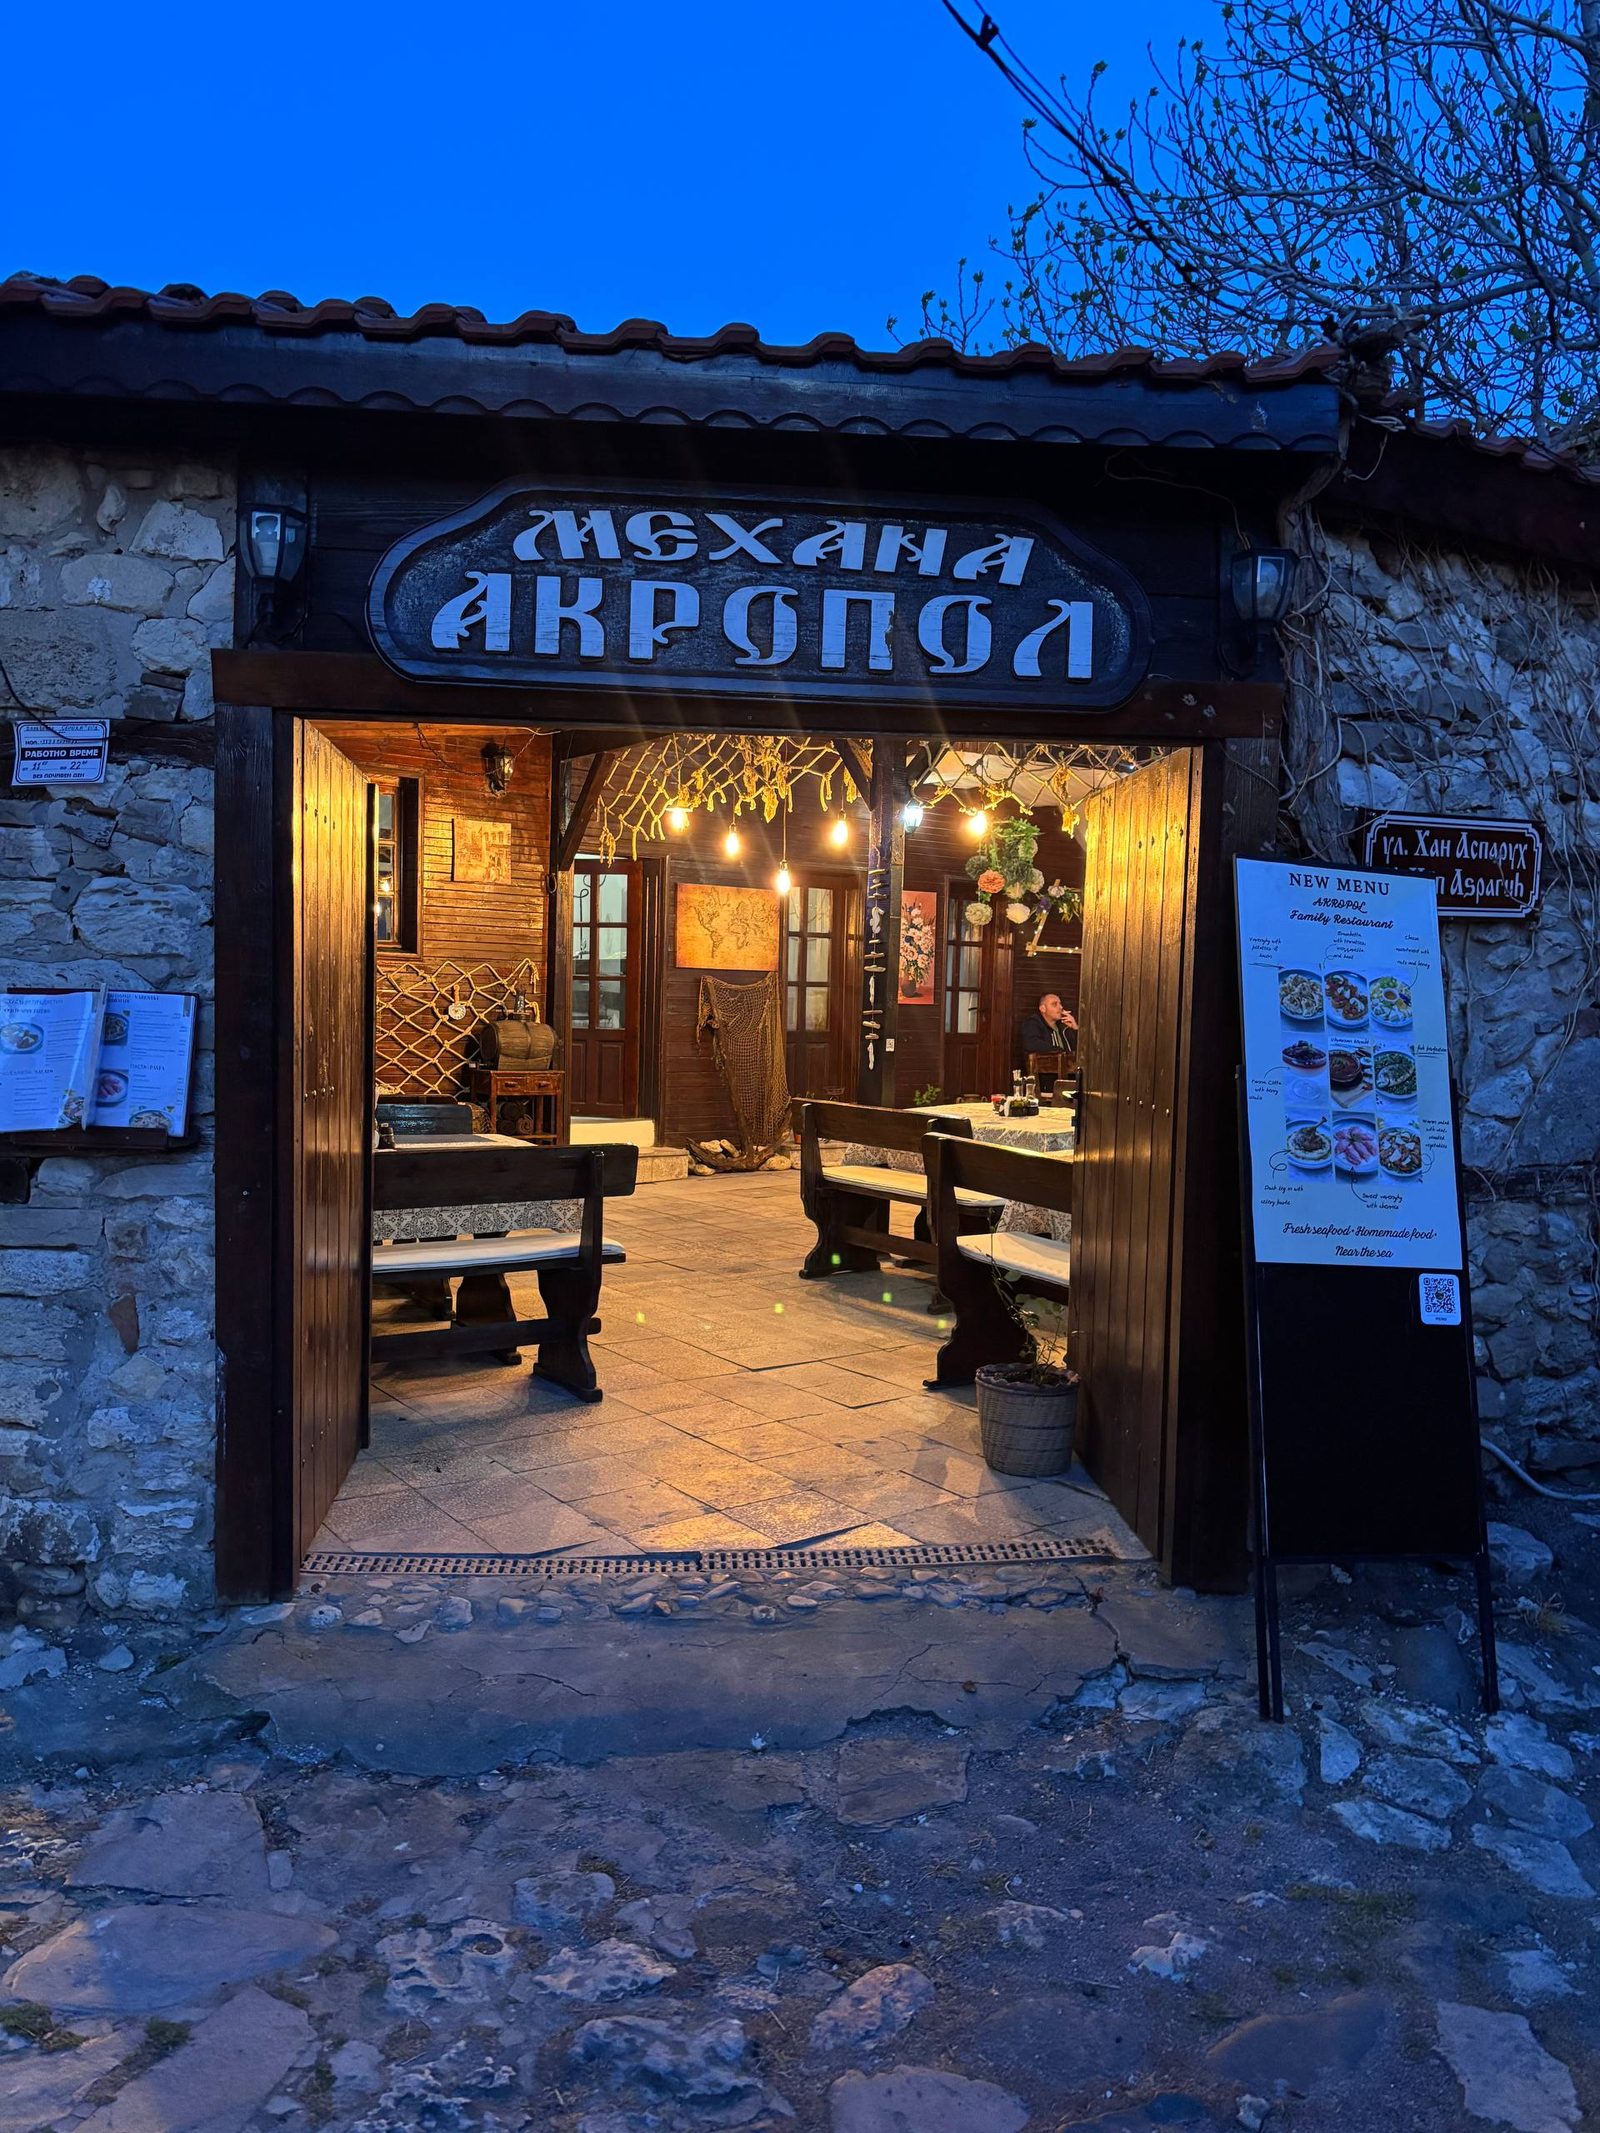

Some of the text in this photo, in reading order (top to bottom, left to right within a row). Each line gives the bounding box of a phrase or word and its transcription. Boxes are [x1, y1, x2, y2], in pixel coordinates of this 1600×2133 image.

[513, 509, 1036, 588] МЕХАНА
[430, 570, 1094, 681] АКРОПОЛ
[24, 748, 99, 758] РАБОТНО ВРЕМЕ
[1383, 829, 1528, 870] ул. Хан Аспарух
[1289, 873, 1330, 889] NEW
[1336, 877, 1390, 896] MENU
[1312, 897, 1368, 914] AKROPOL
[1289, 909, 1394, 930] Family Restaurant
[1283, 1222, 1434, 1242] Fresh seafood Homemade food
[1335, 1245, 1394, 1258] Near the sea
